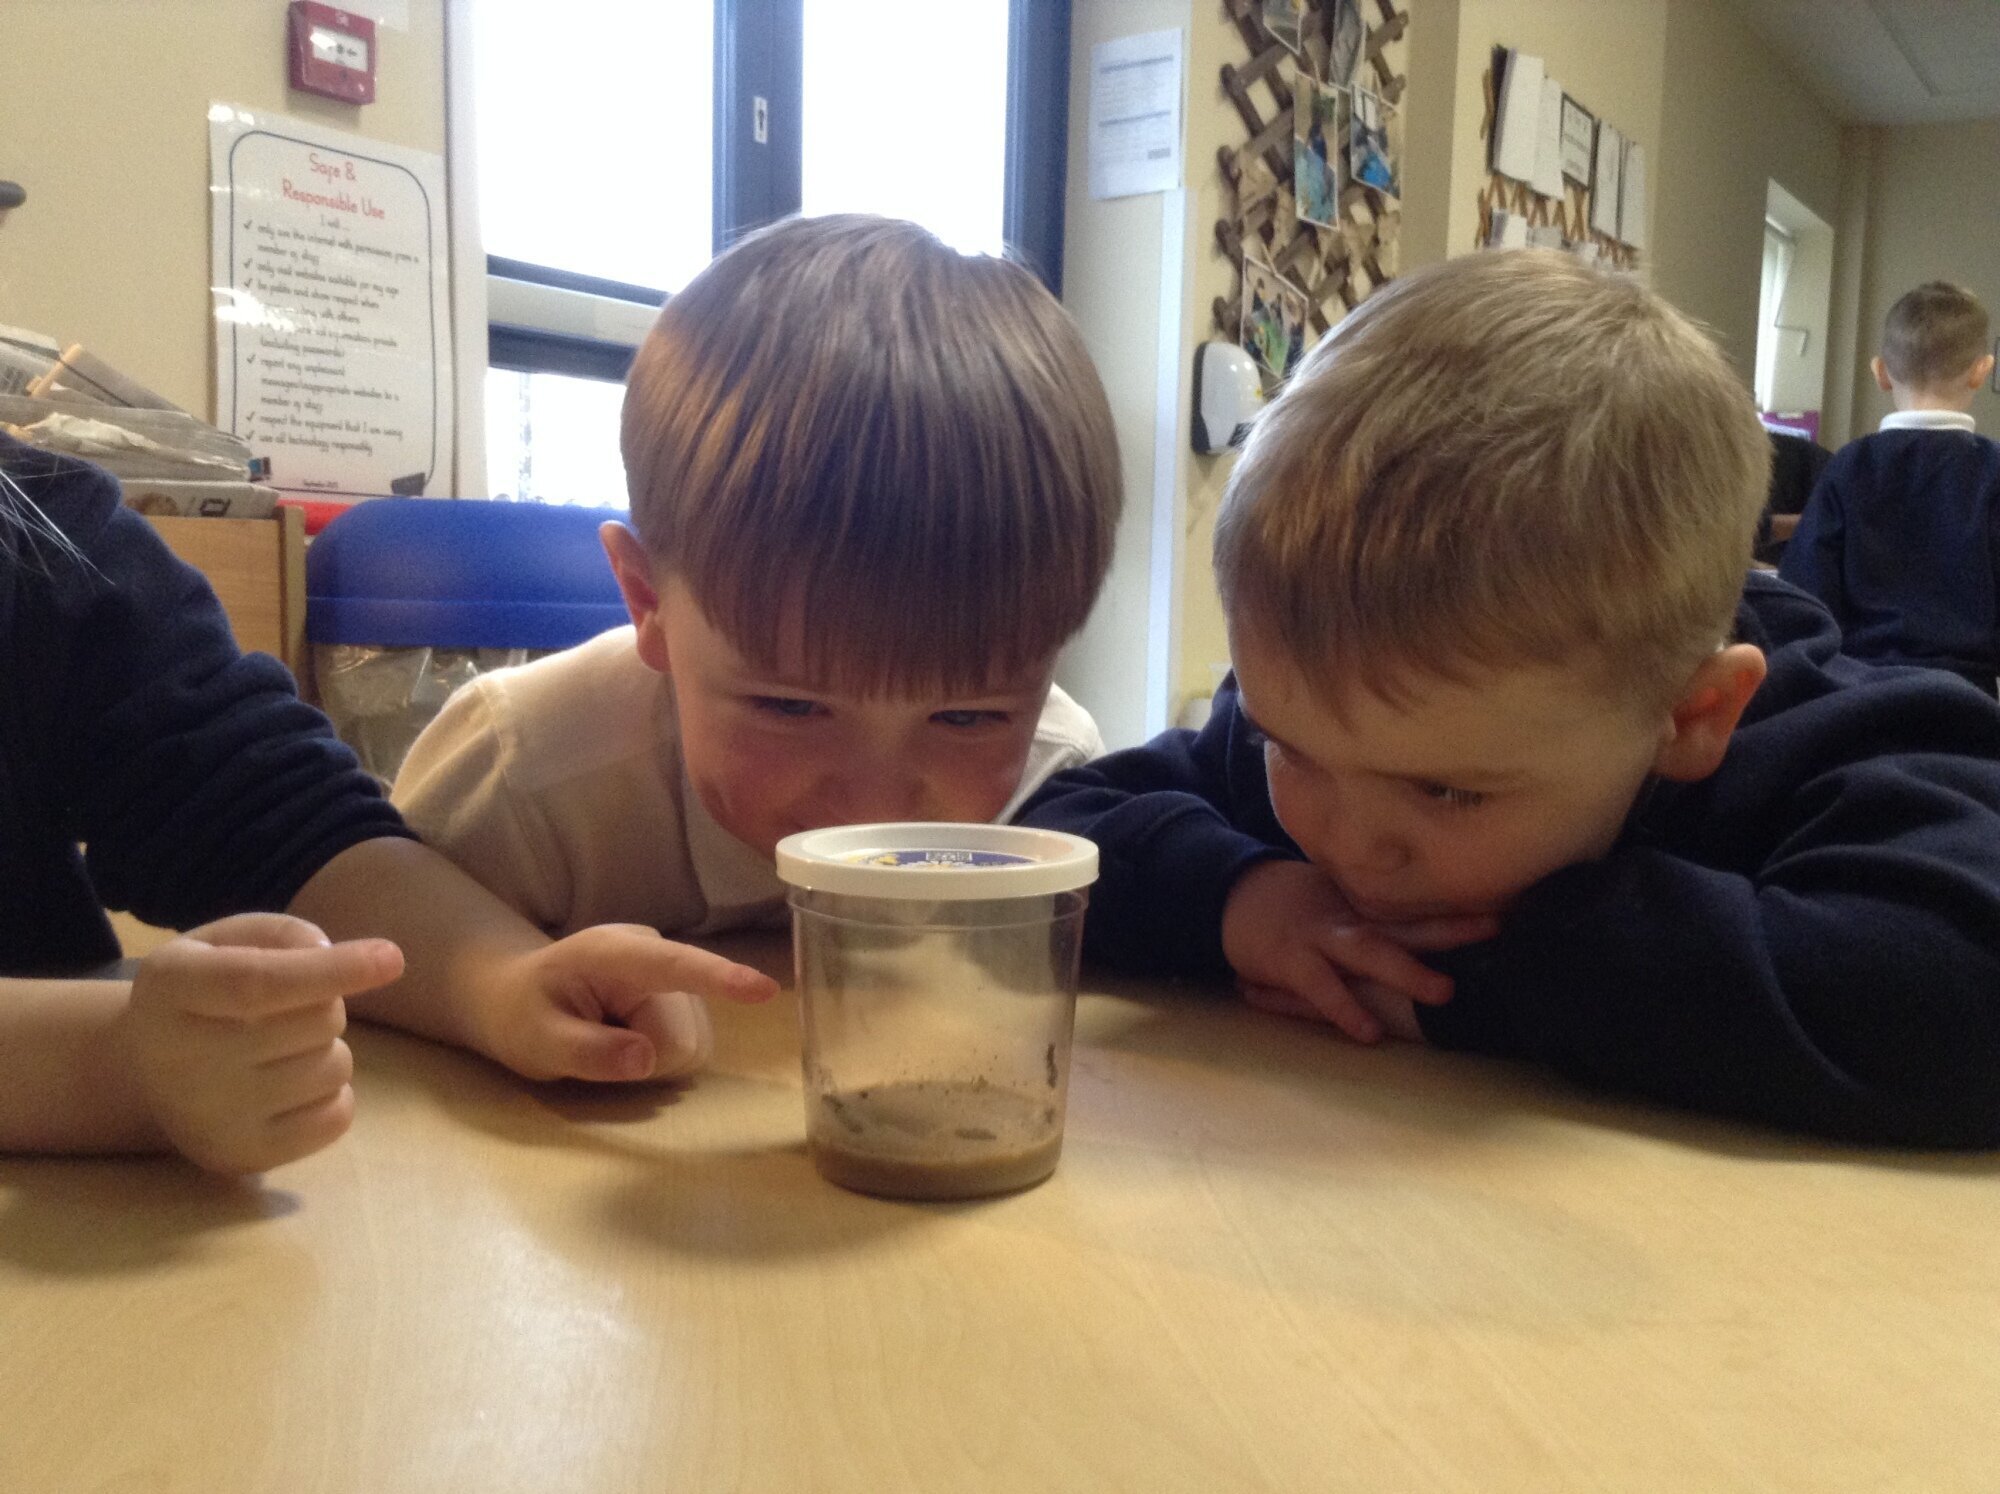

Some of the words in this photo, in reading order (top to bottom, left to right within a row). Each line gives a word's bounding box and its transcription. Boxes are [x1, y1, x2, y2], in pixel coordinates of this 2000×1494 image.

[309, 152, 340, 184] Safe
[345, 161, 356, 181] &
[282, 177, 358, 213] Responsible
[361, 196, 385, 219] Use
